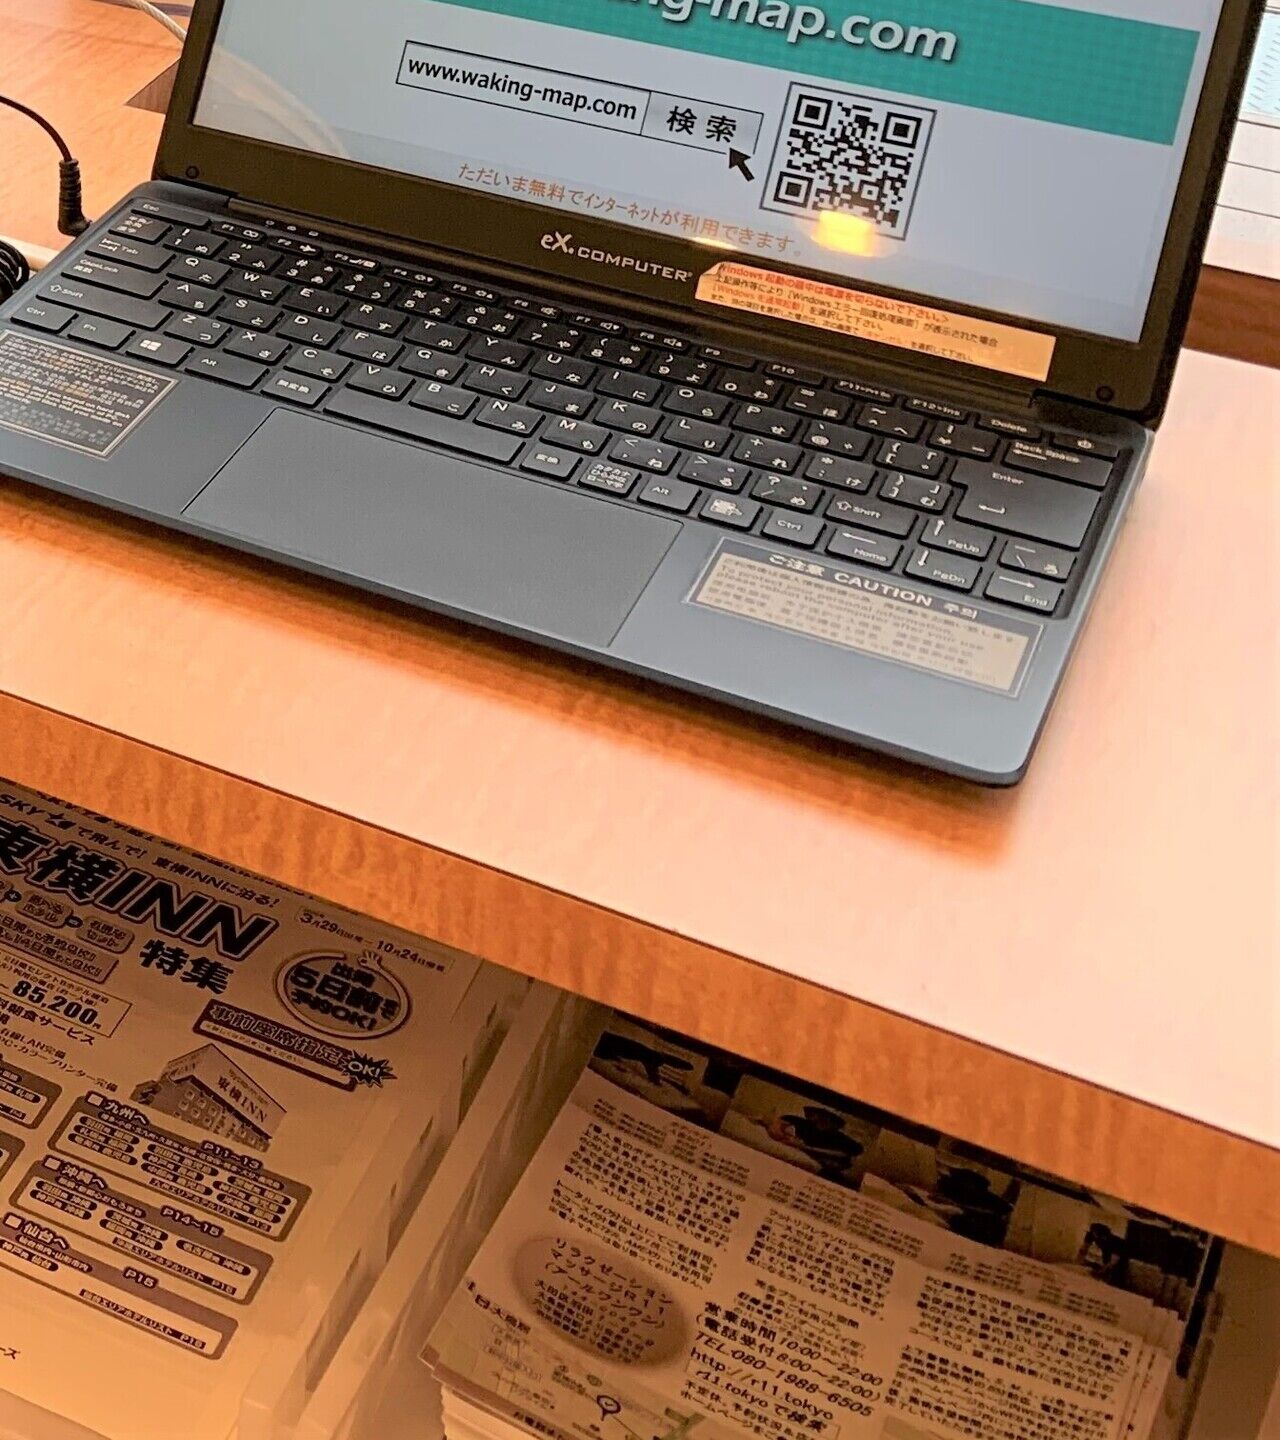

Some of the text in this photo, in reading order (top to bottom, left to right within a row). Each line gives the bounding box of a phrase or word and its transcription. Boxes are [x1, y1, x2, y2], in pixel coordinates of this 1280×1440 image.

[407, 57, 639, 120] www.waking-map.com
[142, 203, 160, 212] Esc
[120, 246, 139, 256] Tab
[79, 258, 120, 274] CapsLock
[185, 257, 199, 267] Q
[243, 271, 261, 283] W
[176, 282, 190, 293] A
[299, 287, 314, 298] E
[60, 288, 84, 299] Shift
[235, 298, 249, 309] S
[359, 304, 374, 314] R
[25, 306, 46, 317] Ctrl
[182, 314, 198, 325] Z
[294, 315, 309, 325] D
[423, 319, 437, 330] T
[241, 331, 257, 341] X
[354, 331, 370, 341] F
[486, 336, 499, 347] Y
[302, 348, 318, 358] C
[417, 348, 434, 360] G
[547, 353, 562, 364] U
[201, 357, 218, 367] Alt
[367, 365, 381, 375] V
[479, 365, 496, 377] H
[611, 370, 620, 380] I
[426, 382, 442, 394] B
[545, 384, 557, 394] J
[678, 388, 695, 399] O
[491, 400, 509, 411] N
[611, 401, 628, 413] K
[746, 405, 762, 414] P
[559, 419, 577, 431] M
[679, 418, 691, 430] L
[990, 418, 1028, 434] Delete
[991, 471, 1024, 486] Enter
[851, 505, 882, 519] Shift
[947, 538, 980, 554] PgUp
[853, 546, 888, 562] Home
[933, 568, 966, 585] PgDn
[767, 553, 979, 620] ご注意 CAUTION 주의
[1023, 594, 1047, 608] End
[139, 938, 235, 995] 特集
[345, 1057, 382, 1079] OK!
[103, 1100, 150, 1126] 九州へ
[60, 1163, 109, 1191] 沖縄へ
[21, 1221, 72, 1251] 仙台へ
[553, 1236, 674, 1306] リラクゼーション
[702, 1300, 778, 1342] 営業時間
